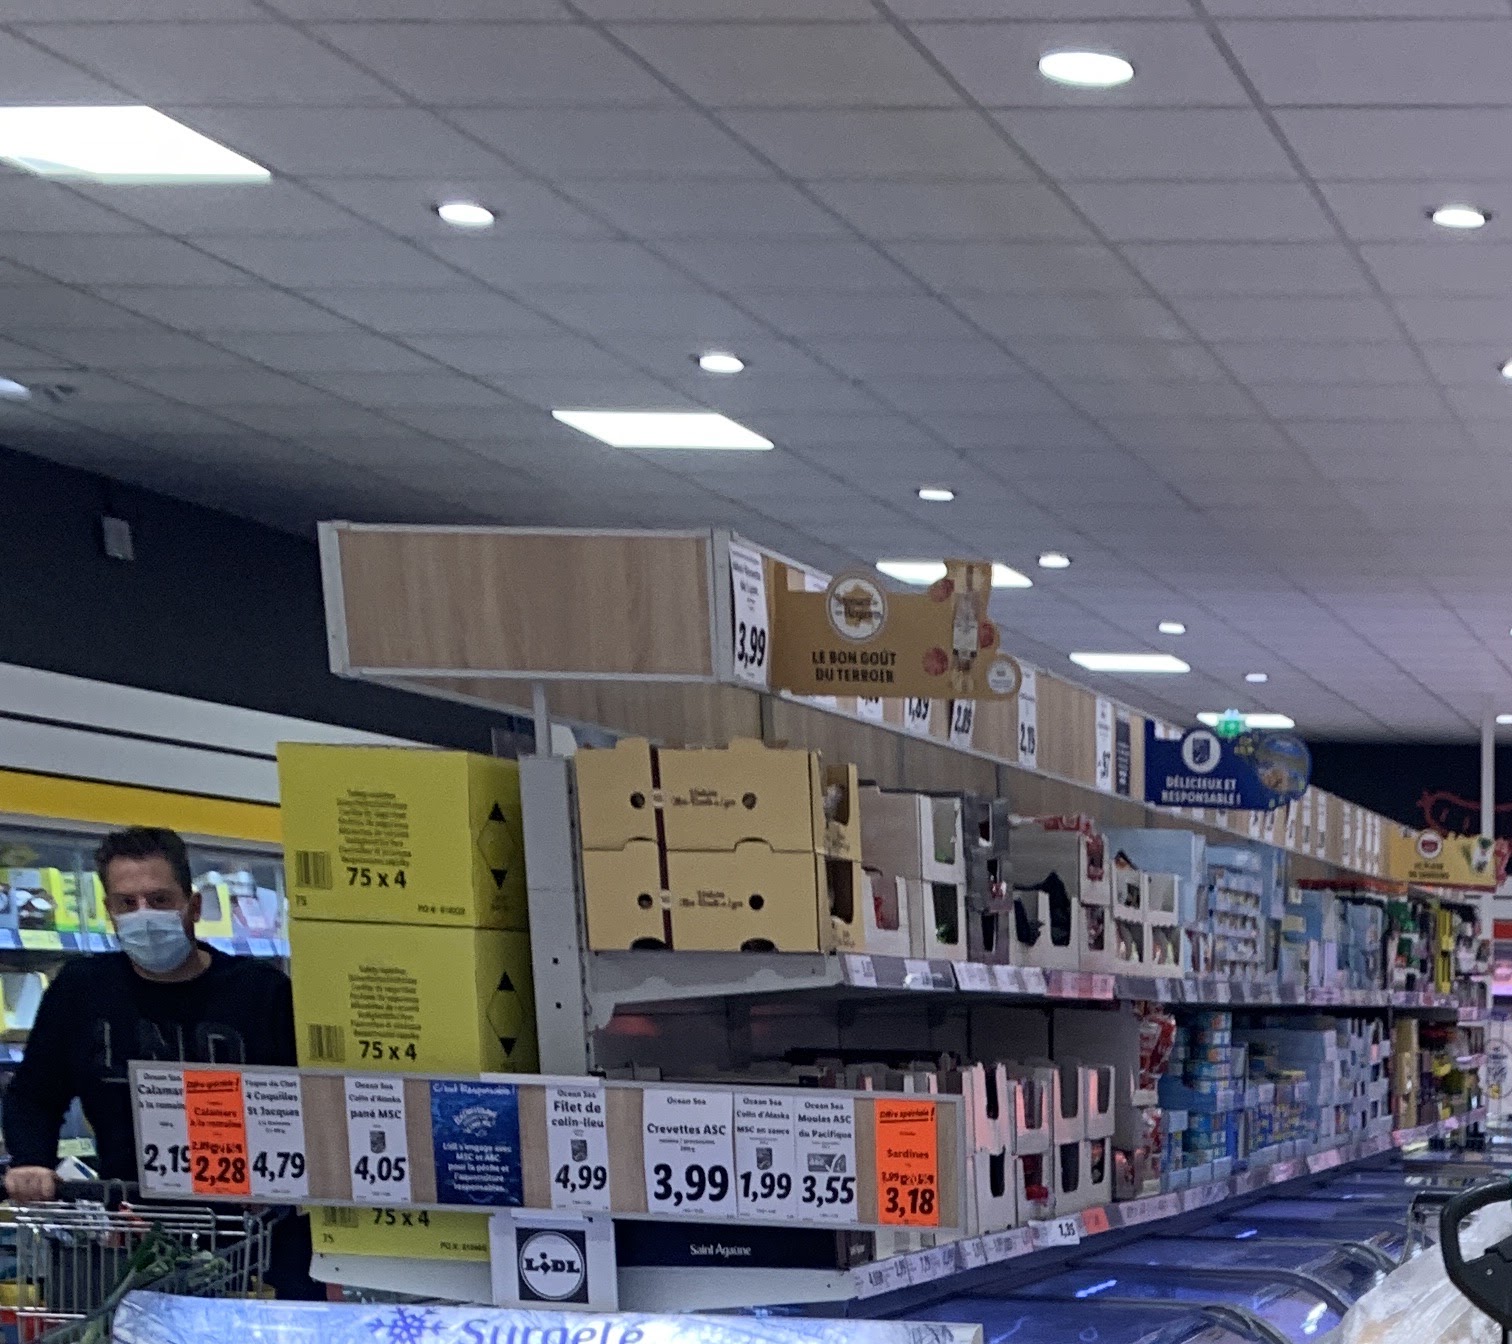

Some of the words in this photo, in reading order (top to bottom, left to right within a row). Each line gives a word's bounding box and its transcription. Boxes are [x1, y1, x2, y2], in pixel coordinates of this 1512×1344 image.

[738, 622, 767, 669] 3,99
[812, 651, 825, 664] LE
[815, 668, 834, 682] DU
[836, 669, 895, 683] TERROIR
[1224, 779, 1237, 790] ET
[347, 867, 372, 887] 75
[378, 874, 389, 888] x
[394, 869, 407, 888] 4
[359, 1040, 383, 1059] 75
[388, 1046, 400, 1060] x
[404, 1043, 418, 1061] 4
[351, 1109, 376, 1120] pané
[378, 1110, 402, 1119] MSC
[553, 1100, 582, 1113] Filet
[585, 1100, 602, 1113] de
[647, 1123, 701, 1136] Crevettes
[703, 1124, 727, 1136] ASC
[830, 1114, 852, 1125] ASC
[886, 1147, 930, 1160] Sardines
[194, 1156, 246, 1186] 2,28
[252, 1151, 305, 1182] 4,79
[354, 1156, 407, 1184] 4,05
[555, 1164, 607, 1192] 4,99
[653, 1163, 730, 1207] 3,99
[739, 1171, 792, 1202] 1,99
[802, 1175, 856, 1207] 3,55
[885, 1186, 935, 1217] 3,18
[372, 1208, 396, 1226] 75
[402, 1213, 412, 1226] x
[417, 1210, 430, 1227] 4
